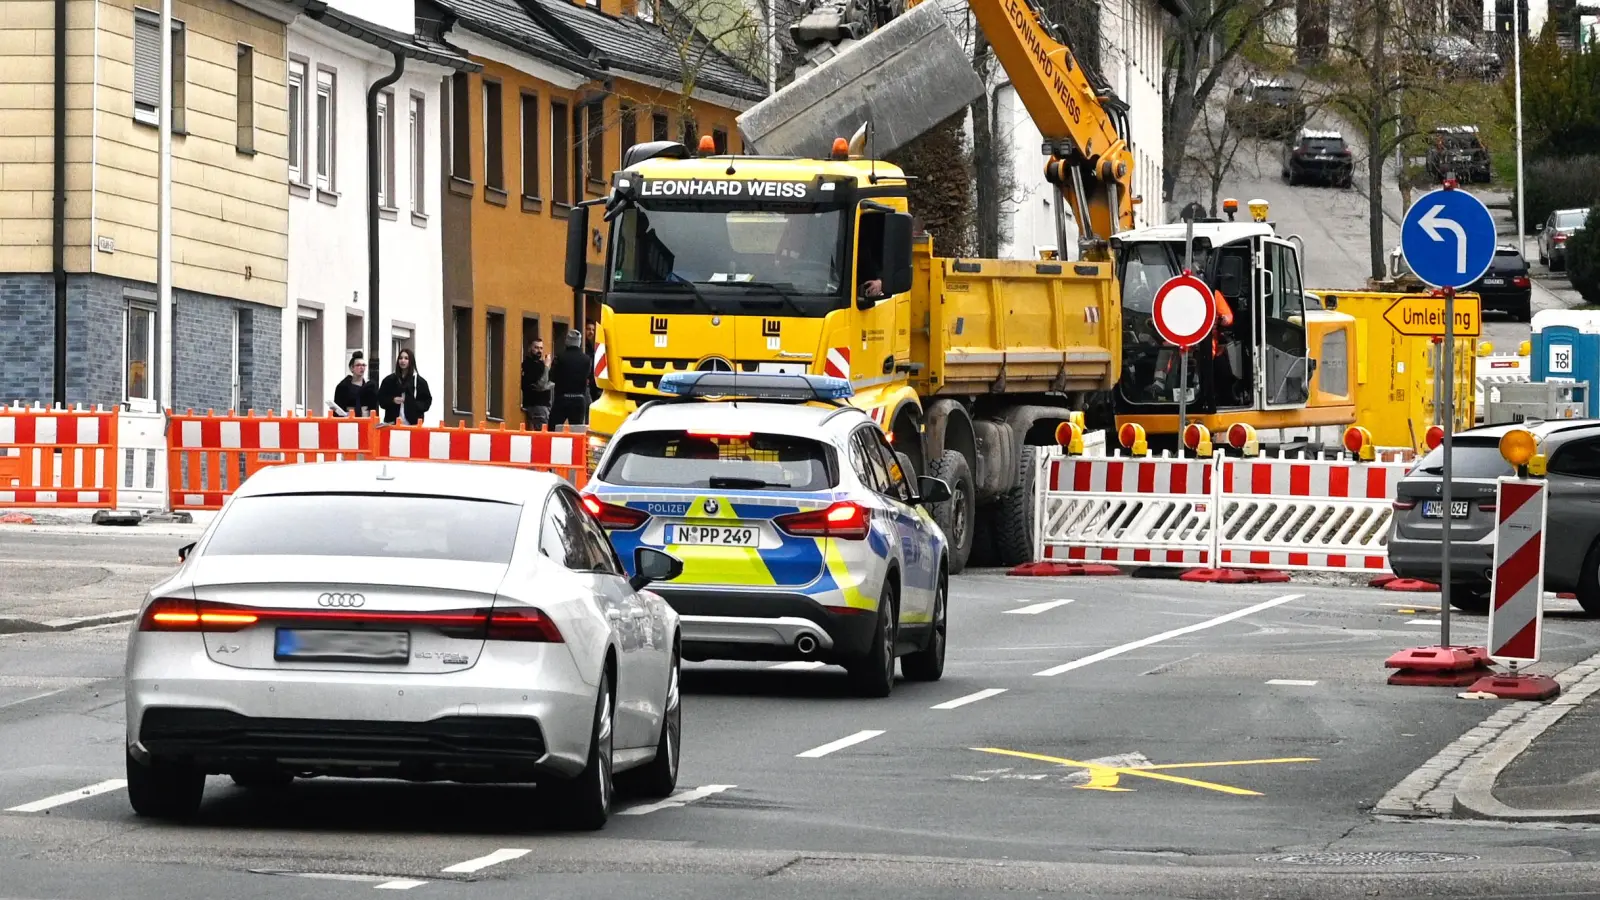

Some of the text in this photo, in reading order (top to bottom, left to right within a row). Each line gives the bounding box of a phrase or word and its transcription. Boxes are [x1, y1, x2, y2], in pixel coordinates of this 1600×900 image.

[1004, 0, 1081, 125] LEONHARD WEISS
[641, 180, 807, 198] LEONHARD WEISS
[1403, 307, 1471, 330] Umleitng
[648, 503, 686, 513] POLIZEI
[679, 527, 752, 544] N PP 249
[216, 644, 241, 653] A7
